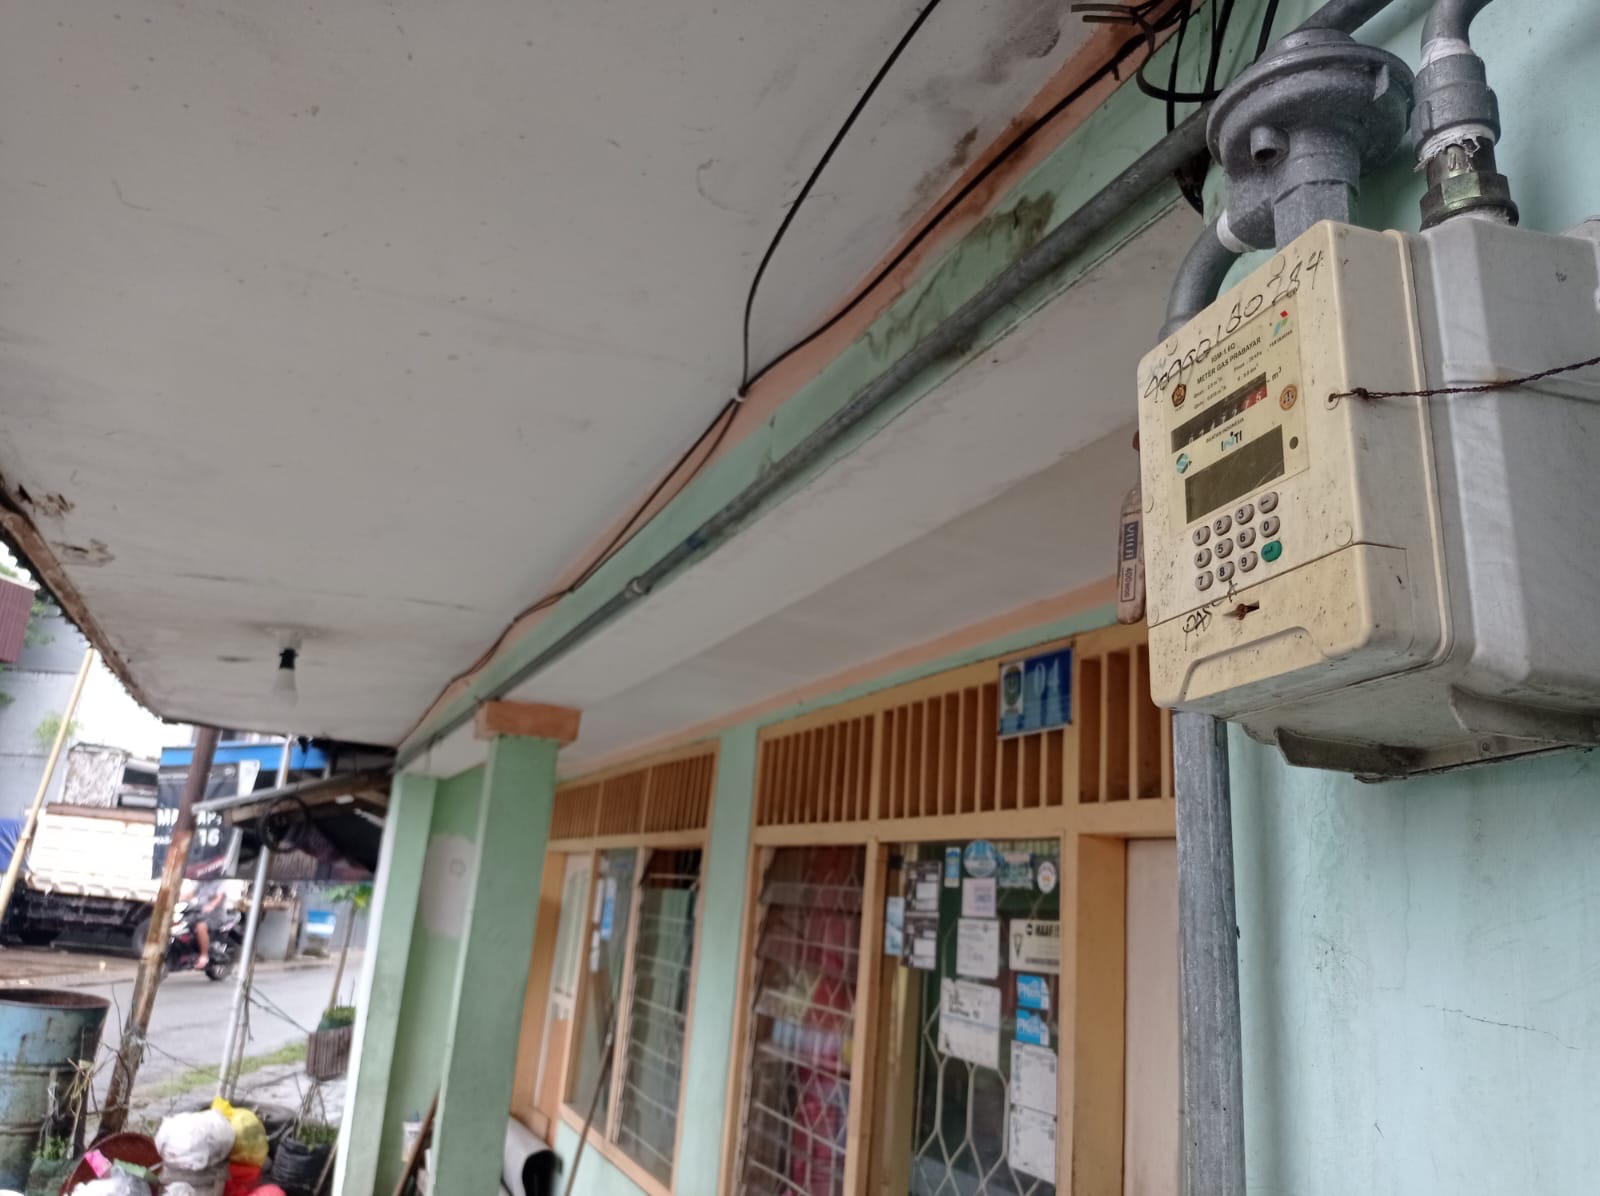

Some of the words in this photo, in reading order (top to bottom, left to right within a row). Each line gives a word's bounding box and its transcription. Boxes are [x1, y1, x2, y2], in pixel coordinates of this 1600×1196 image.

[1197, 368, 1216, 384] METER
[1217, 358, 1229, 371] GAS
[1230, 336, 1261, 362] PRABAYAR
[1216, 520, 1222, 530] 2
[1238, 508, 1244, 519] 3
[1197, 552, 1202, 562] 4
[1218, 543, 1223, 553] 5
[1240, 532, 1245, 542] 6
[1263, 521, 1269, 531] 0
[1198, 576, 1203, 585] 7
[1220, 567, 1225, 577] 8
[1242, 557, 1247, 567] 9
